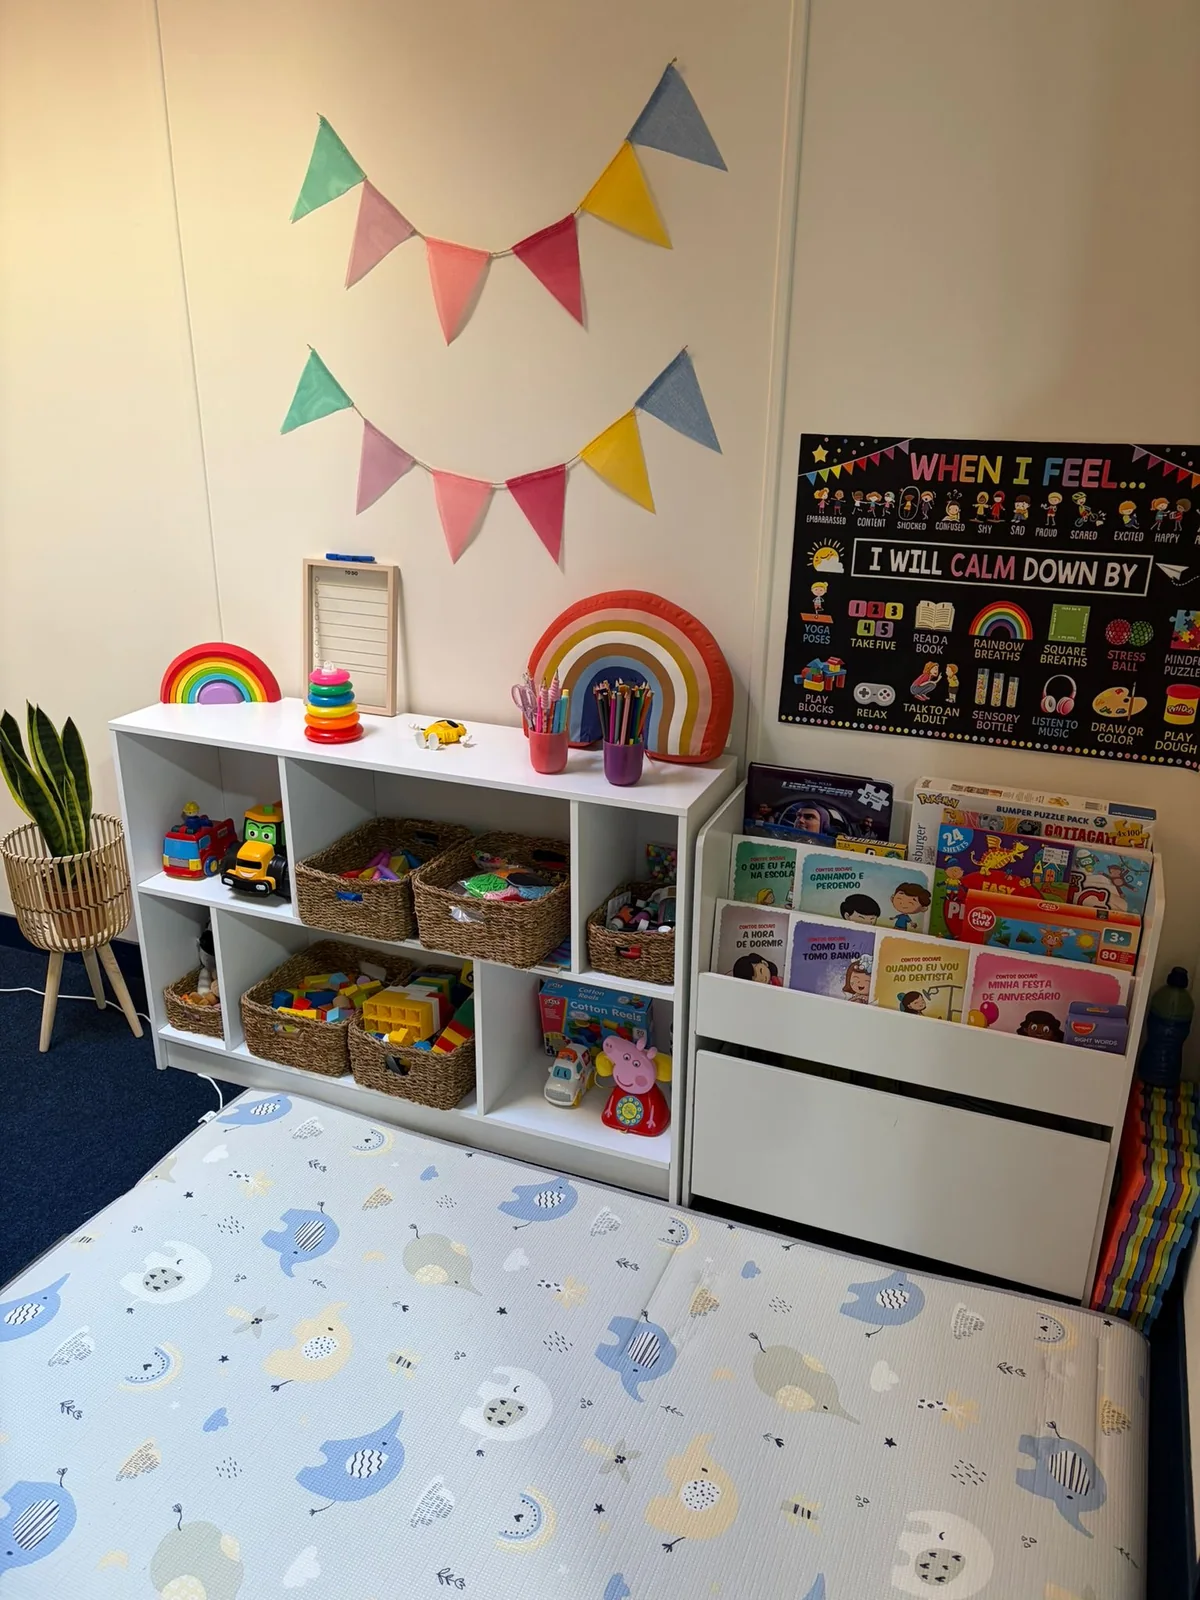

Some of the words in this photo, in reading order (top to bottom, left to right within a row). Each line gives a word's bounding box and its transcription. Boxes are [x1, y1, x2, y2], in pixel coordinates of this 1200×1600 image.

[910, 452, 1003, 485] WHEN
[1013, 456, 1032, 485] I
[806, 515, 847, 525] EMBARRASSED
[857, 517, 886, 527] CONTENT
[897, 521, 926, 531] SHOCKED
[935, 522, 965, 532] CONFUSED
[977, 524, 993, 534] SHY
[1010, 525, 1026, 536] SAD
[1035, 527, 1058, 538] PROUD
[1070, 530, 1098, 540] SCARED
[1114, 531, 1144, 542] EXCITED
[1154, 533, 1180, 544] HAPPY
[869, 546, 883, 571] I
[890, 548, 942, 576] WILL
[950, 552, 1016, 580] CALM
[1023, 556, 1098, 586] DOWN
[1104, 562, 1138, 588] BY
[871, 603, 880, 615] 2
[890, 605, 898, 617] 3
[804, 623, 830, 635] YOGA
[863, 622, 871, 634] 4
[880, 623, 888, 635] 5
[803, 633, 831, 645] POSES
[850, 638, 875, 649] TAKE
[876, 640, 897, 650] FIVE
[913, 633, 940, 644] READ
[940, 635, 948, 645] A
[973, 638, 1025, 651] RAINBOW
[915, 643, 944, 655] BOOK
[1043, 644, 1087, 657] SQUARE
[974, 649, 1021, 661] BREATHS
[1107, 650, 1146, 662] STRESS
[1040, 655, 1088, 667] BREATHS
[1111, 660, 1138, 672] BALL
[805, 694, 829, 705] PLAY
[798, 702, 834, 714] BLOCKS
[856, 708, 888, 719] RELAX
[903, 703, 929, 714] TALK
[930, 704, 944, 715] TO
[944, 707, 960, 717] AN
[913, 713, 948, 725] ADULT
[972, 709, 1021, 724] SENSORY
[976, 720, 1014, 733] BOTTLE
[1032, 716, 1067, 728] LISTEN
[1067, 719, 1079, 730] TO
[1038, 727, 1069, 739] MUSIC
[1090, 722, 1128, 734] DRAW
[1128, 725, 1144, 737] OR
[1097, 733, 1134, 745] COLOR
[1164, 731, 1193, 742] PLAY
[1154, 740, 1198, 755] DOUGH
[863, 791, 871, 799] 5
[996, 805, 1032, 817] BUMPER
[1034, 810, 1065, 822] PUZZLE
[1066, 814, 1089, 825] PACK
[943, 828, 964, 846] 24
[942, 840, 969, 853] SHEETS
[750, 862, 765, 870] QUE
[768, 862, 778, 870] EU
[751, 871, 762, 879] NA
[764, 870, 795, 879] ESCOLA
[810, 873, 856, 882] GANHANDO
[859, 872, 864, 880] E
[816, 881, 861, 890] PERDENDO
[982, 881, 1016, 896] EASY
[971, 911, 993, 921] Play
[972, 919, 991, 927] tive
[743, 931, 749, 939] A
[751, 930, 774, 938] HORA
[1110, 932, 1125, 943] 3+
[736, 940, 747, 949] DE
[750, 939, 783, 948] DORMIR
[810, 942, 836, 951] COMO
[838, 942, 850, 950] EU
[803, 952, 828, 961] TOMO
[830, 951, 861, 960] BANHO
[1101, 950, 1117, 961] 80
[885, 963, 923, 973] QUANDO
[925, 963, 938, 972] EU
[940, 963, 960, 972] VOU
[893, 974, 907, 982] AO
[909, 972, 954, 982] DENTISTA
[988, 980, 1019, 990] MINHA
[1022, 979, 1052, 989] FESTA
[578, 987, 605, 997] Cotton
[578, 993, 600, 1001] Reels
[982, 992, 995, 1001] DE
[997, 989, 1061, 1001] ANIVERSÁRIO
[570, 1001, 608, 1015] Cotton
[612, 1008, 642, 1022] Reels
[1074, 1036, 1093, 1045] SIGHT
[1094, 1037, 1118, 1046] WORDS
